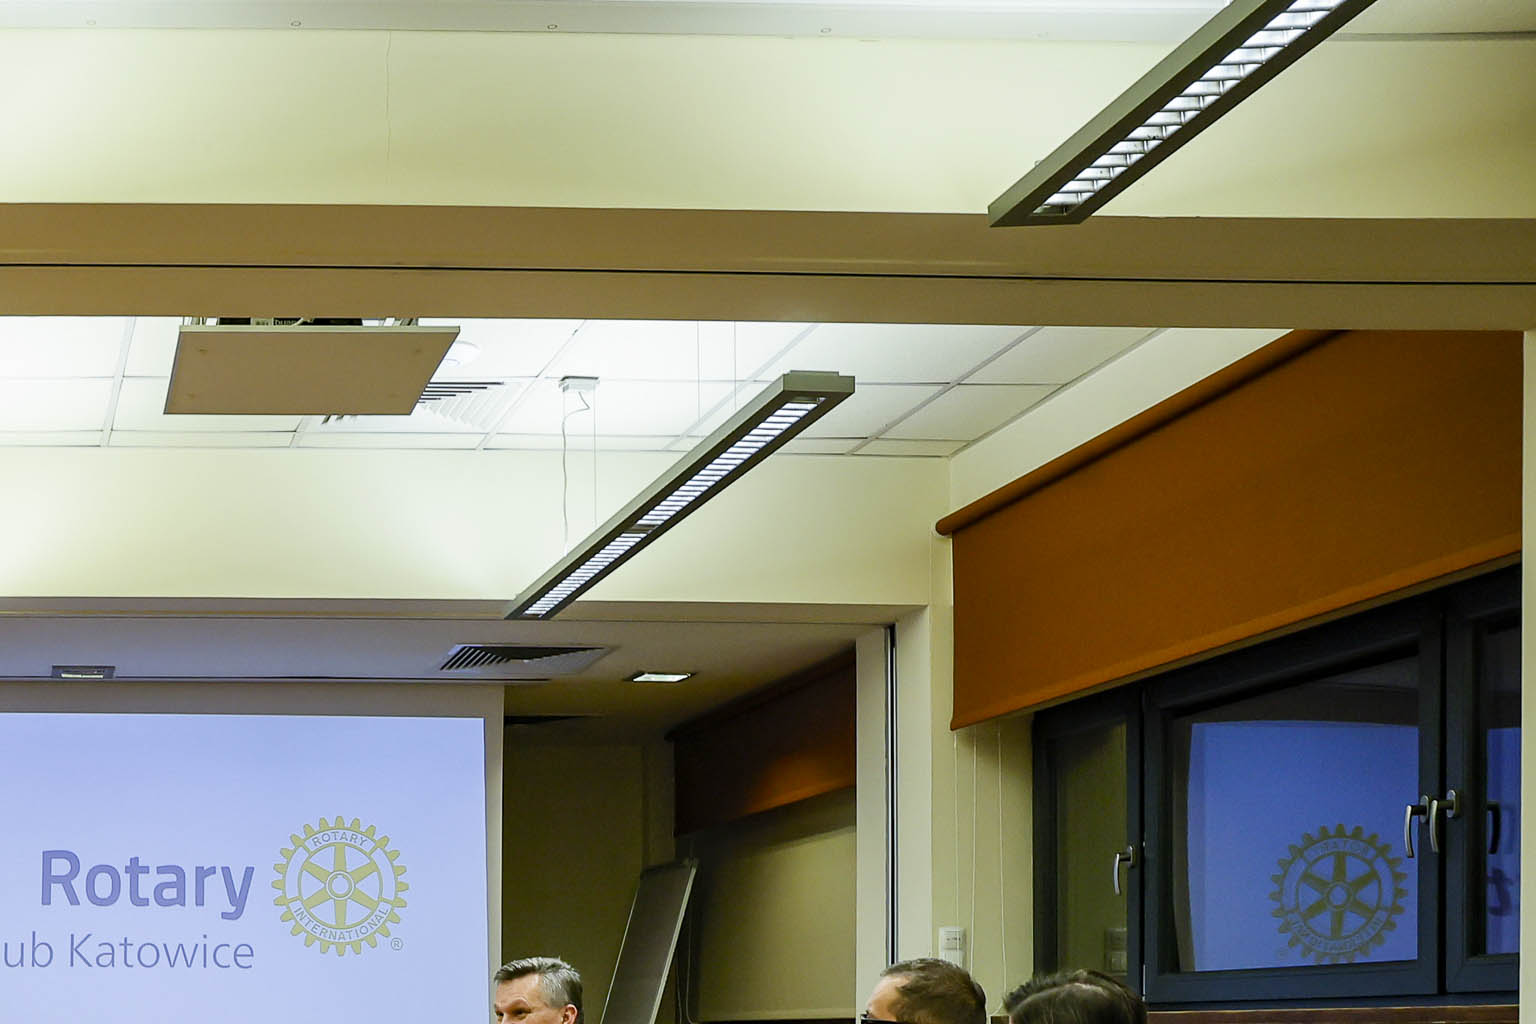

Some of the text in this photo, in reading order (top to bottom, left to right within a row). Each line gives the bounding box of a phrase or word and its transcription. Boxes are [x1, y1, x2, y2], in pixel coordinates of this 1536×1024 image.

[312, 831, 368, 847] ROTARY
[41, 849, 255, 921] Rotary
[293, 906, 389, 941] INTERNATIONAL
[69, 932, 255, 969] Katowice
